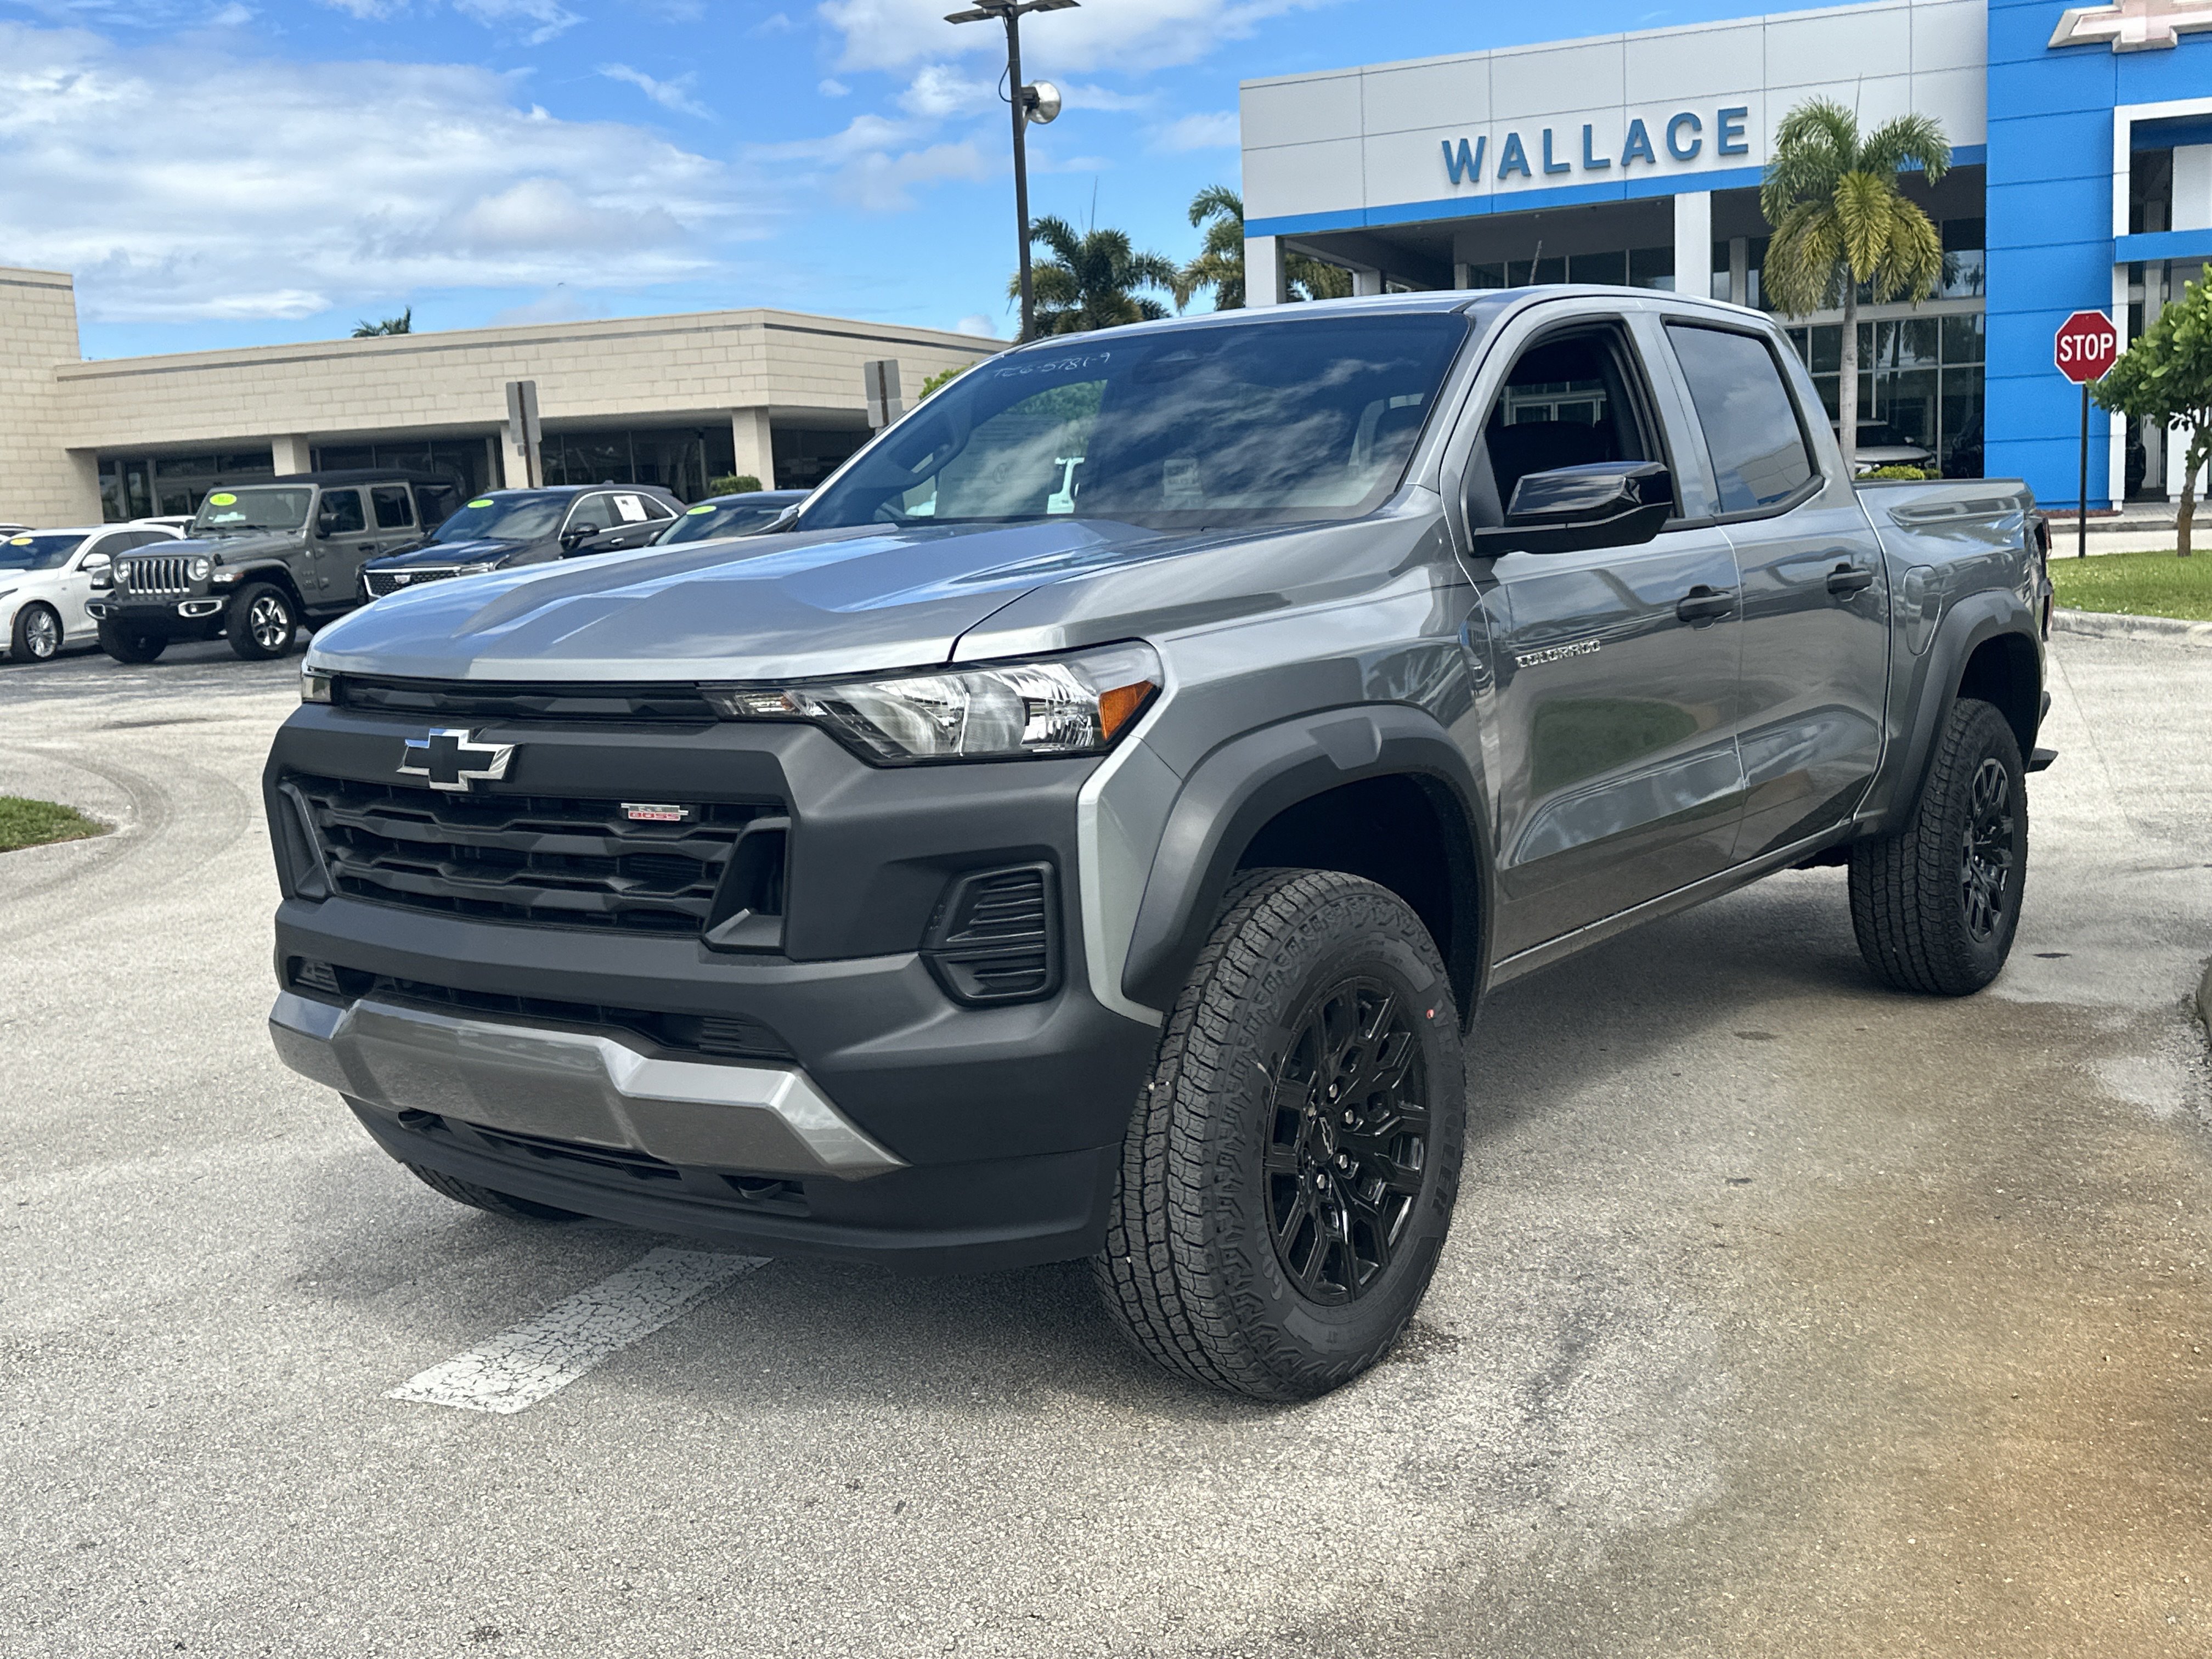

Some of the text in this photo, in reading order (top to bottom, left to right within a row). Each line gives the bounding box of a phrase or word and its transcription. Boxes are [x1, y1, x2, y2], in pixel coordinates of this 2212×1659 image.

[1442, 106, 1749, 184] WALLACE
[2059, 333, 2114, 362] STOP
[1515, 639, 1601, 668] COLORADO
[629, 811, 680, 821] BOSS
